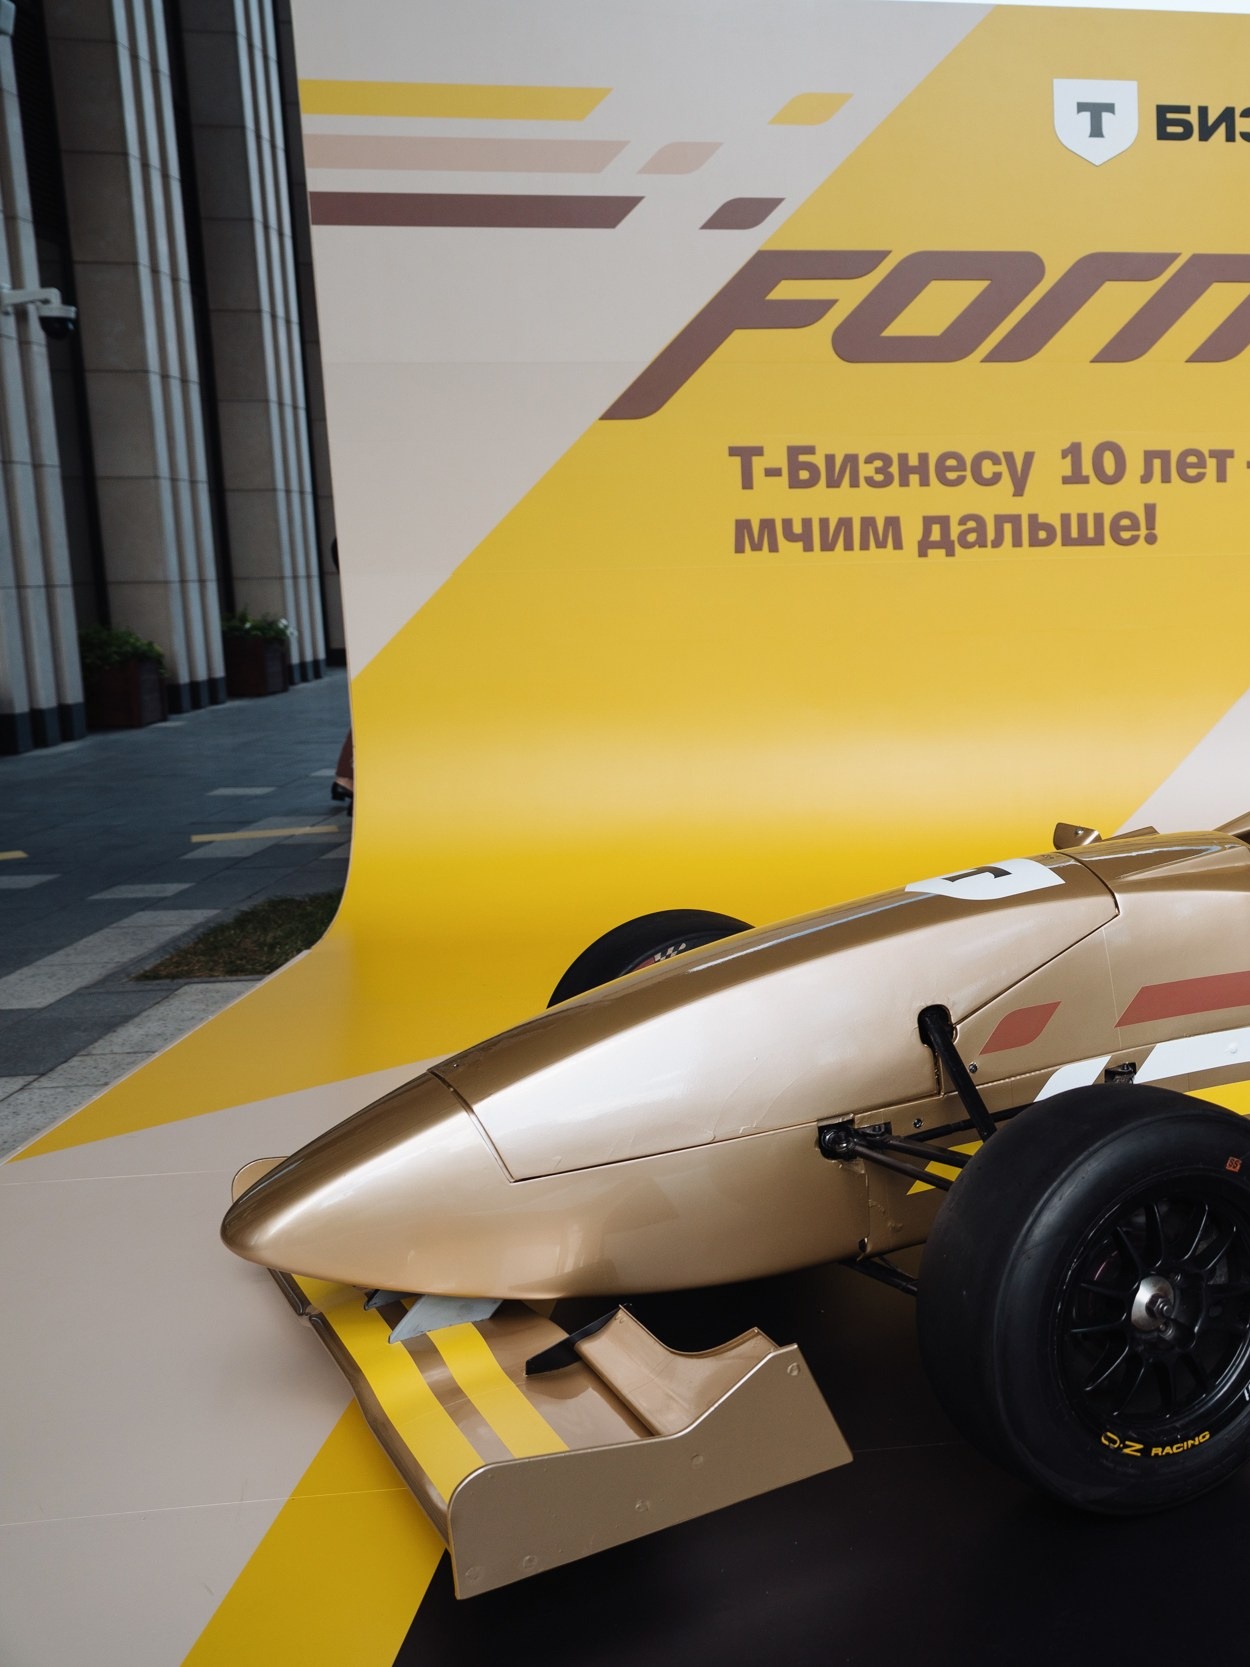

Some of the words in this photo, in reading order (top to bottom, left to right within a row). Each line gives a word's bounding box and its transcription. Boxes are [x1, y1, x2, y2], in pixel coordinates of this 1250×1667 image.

[728, 445, 1036, 498] Т-Бизнесу
[1060, 440, 1127, 485] 10
[1140, 448, 1235, 484] лет
[734, 515, 904, 554] мчим
[917, 502, 1158, 558] дальше!
[1150, 1430, 1211, 1457] RACING
